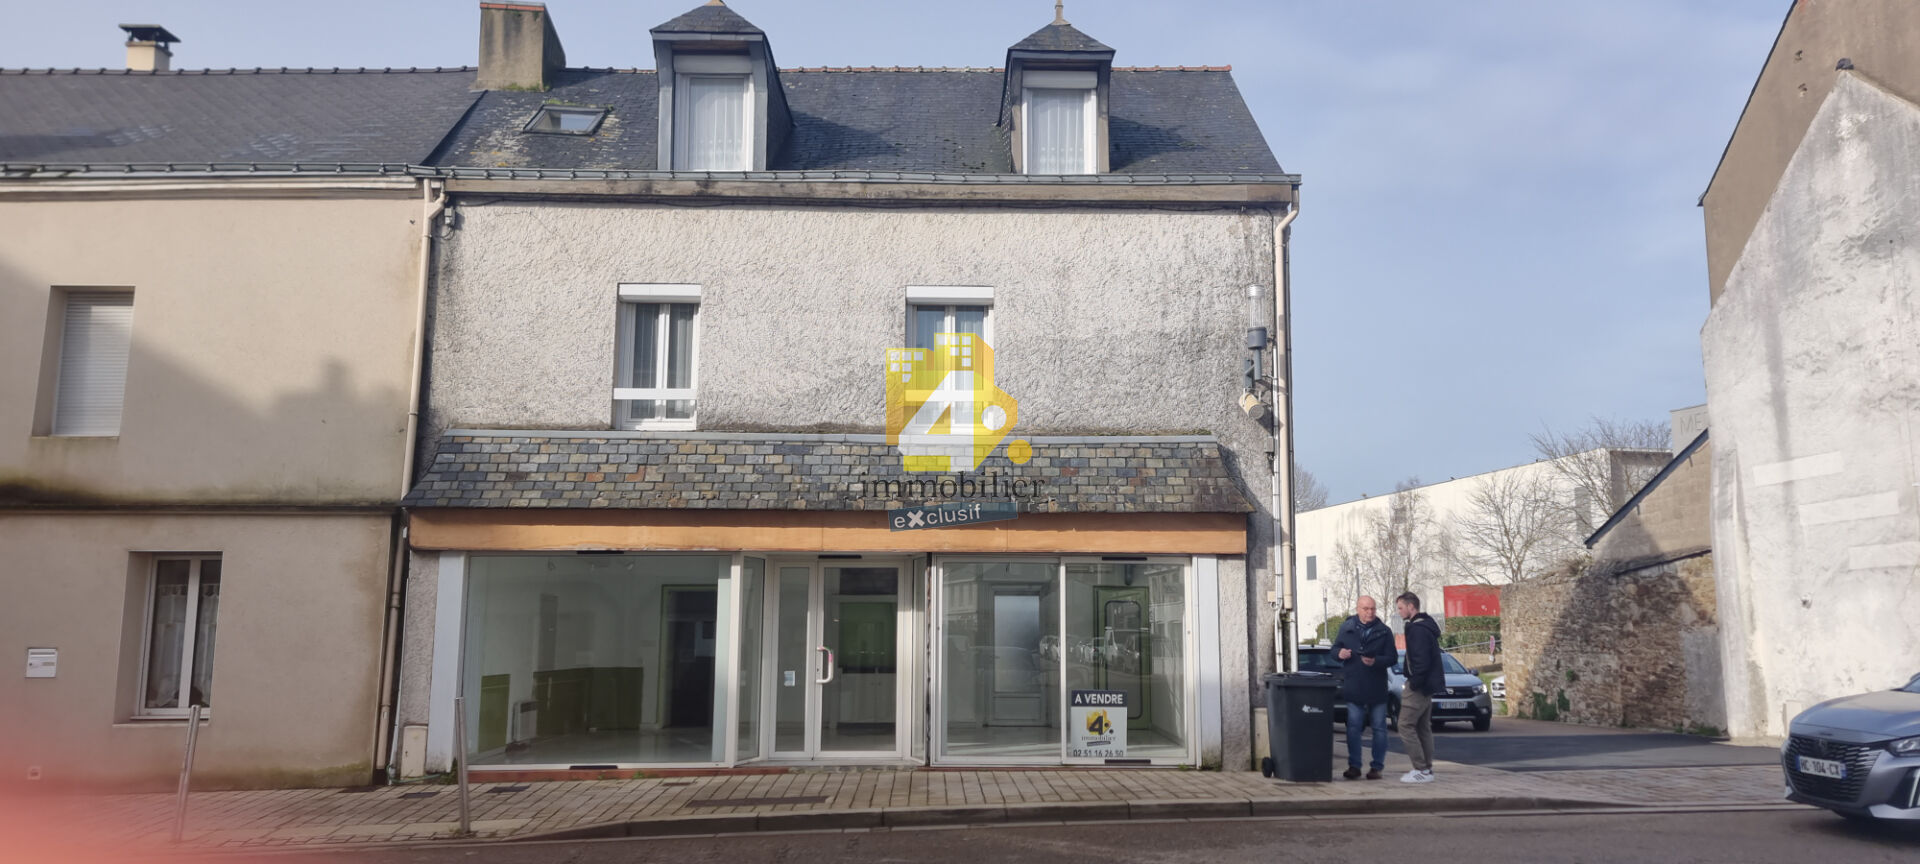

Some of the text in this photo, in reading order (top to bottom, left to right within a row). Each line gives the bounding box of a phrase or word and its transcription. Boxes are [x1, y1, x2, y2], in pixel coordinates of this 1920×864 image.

[1680, 411, 1708, 434] ME
[1074, 693, 1124, 704] A VENDRE
